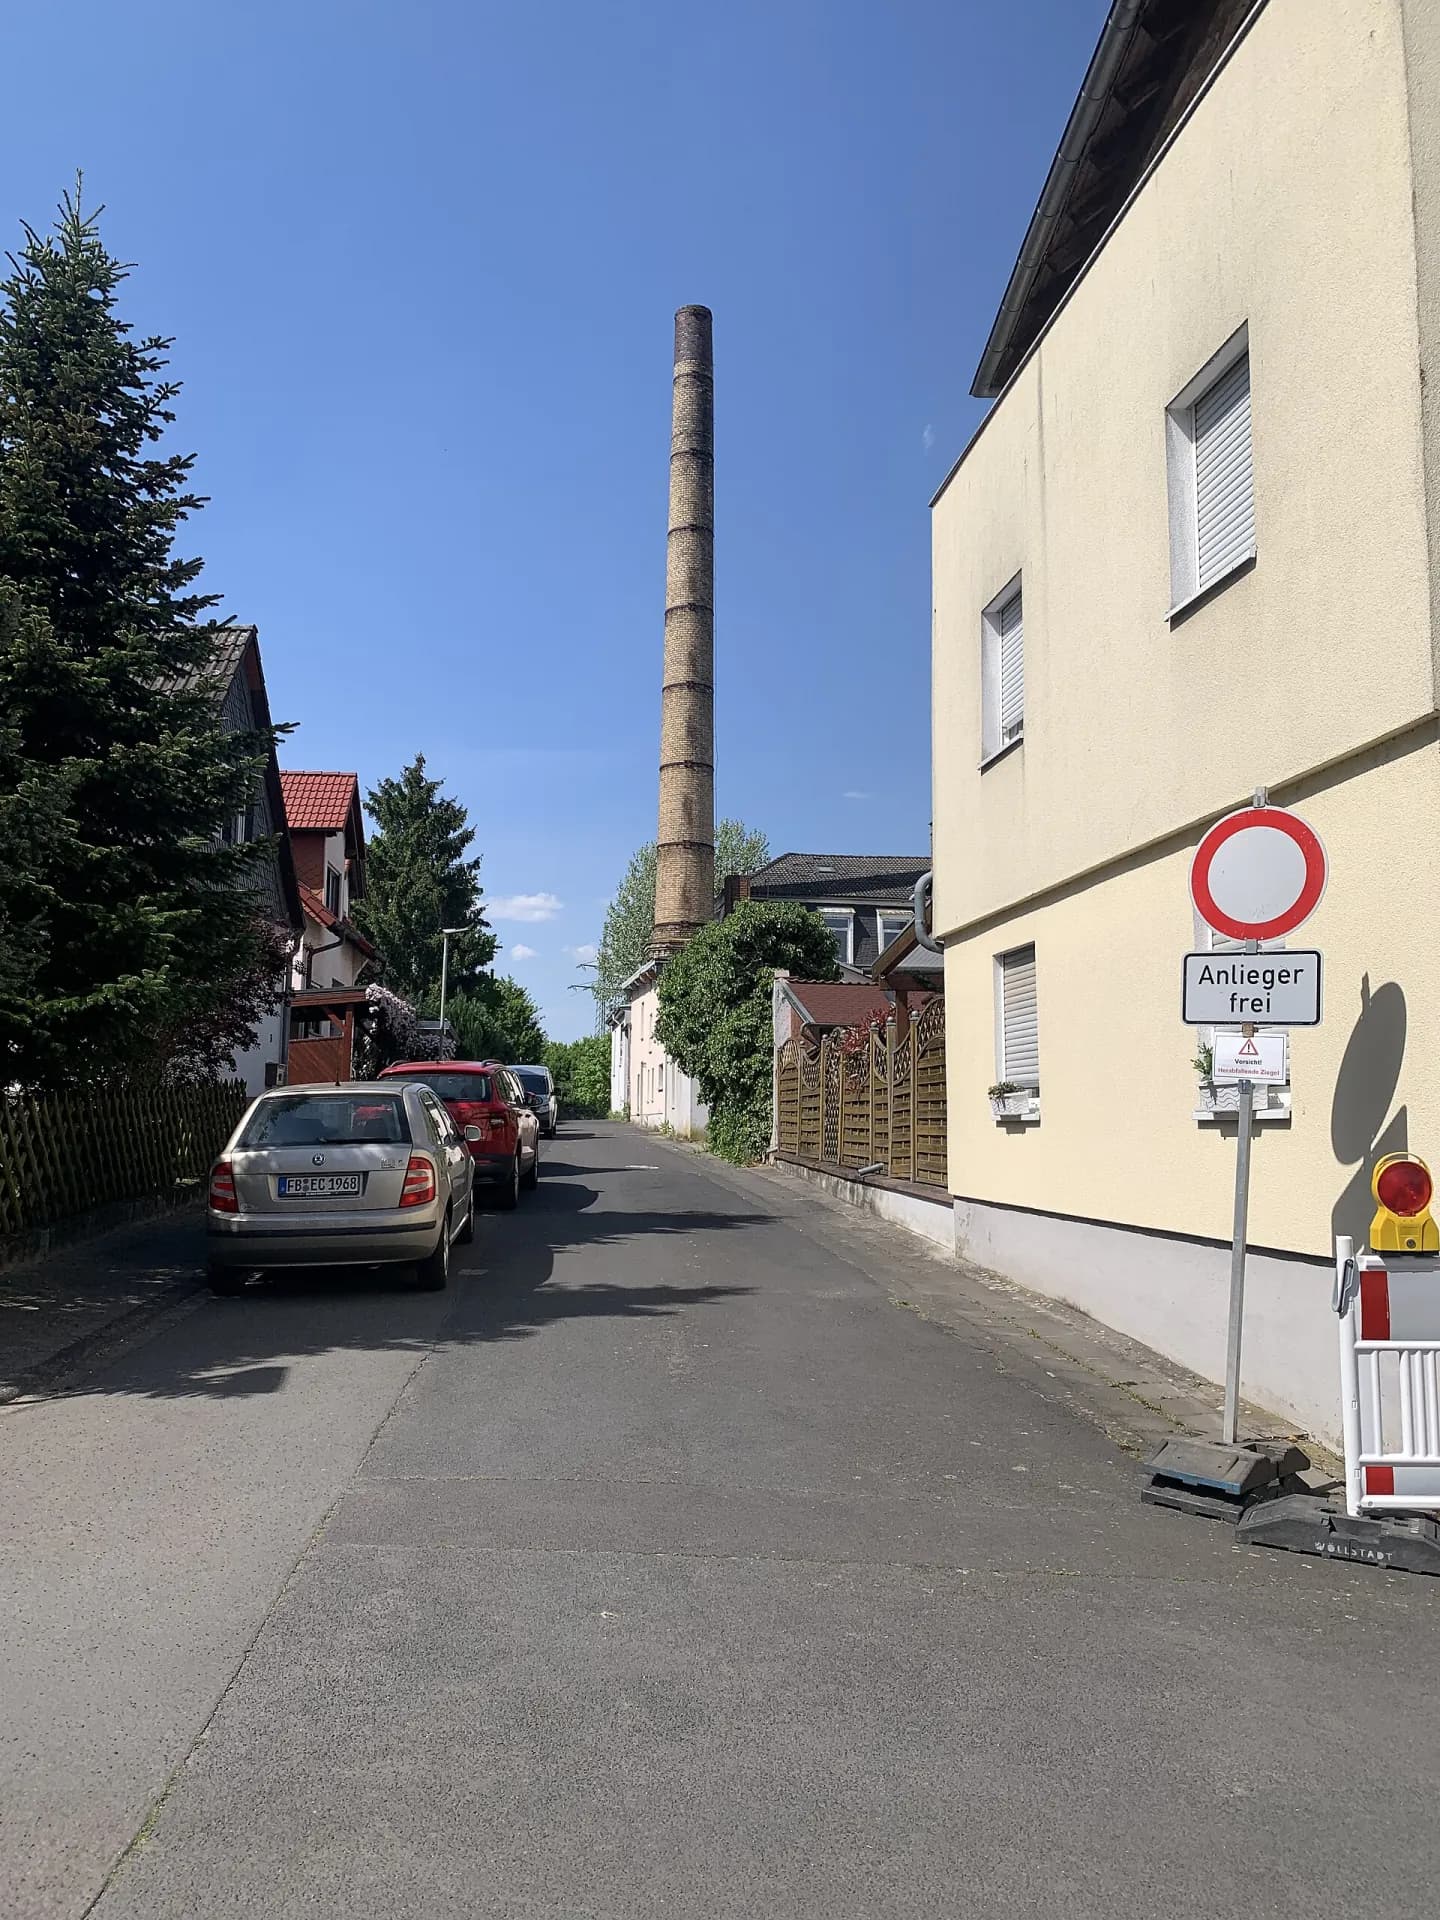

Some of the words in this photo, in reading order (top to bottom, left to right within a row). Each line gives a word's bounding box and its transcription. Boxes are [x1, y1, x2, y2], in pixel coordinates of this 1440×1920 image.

[1198, 964, 1304, 990] Anlieger
[1229, 992, 1271, 1013] frei
[1260, 1069, 1280, 1077] Ziegel
[287, 1179, 302, 1192] FB
[310, 1178, 326, 1191] EC
[328, 1177, 357, 1190] 1968
